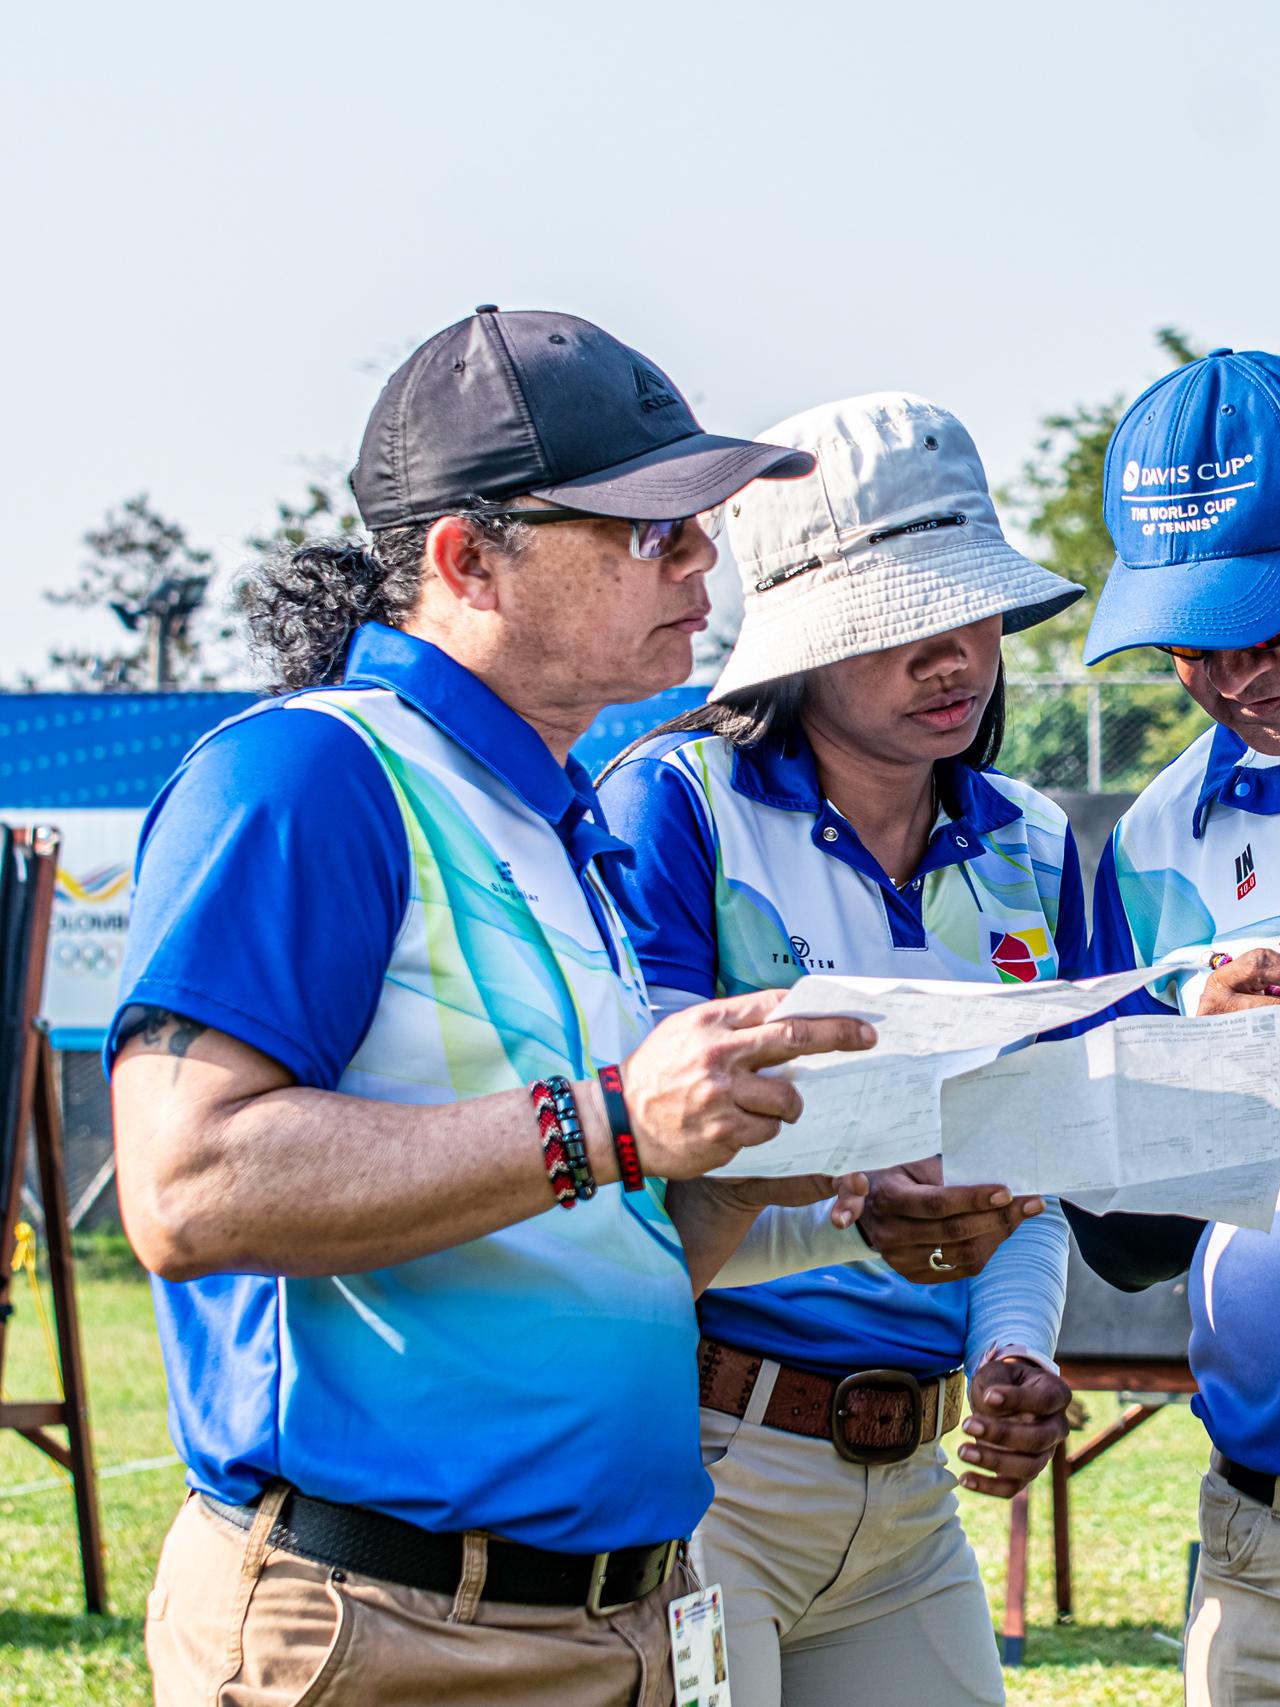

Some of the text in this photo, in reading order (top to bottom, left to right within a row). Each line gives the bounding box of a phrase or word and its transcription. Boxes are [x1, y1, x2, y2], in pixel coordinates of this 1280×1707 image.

[1141, 465, 1190, 486] DAVIS
[1130, 497, 1237, 521] THE WORLD CUP
[1142, 523, 1155, 536] OF
[1235, 843, 1254, 885] IN
